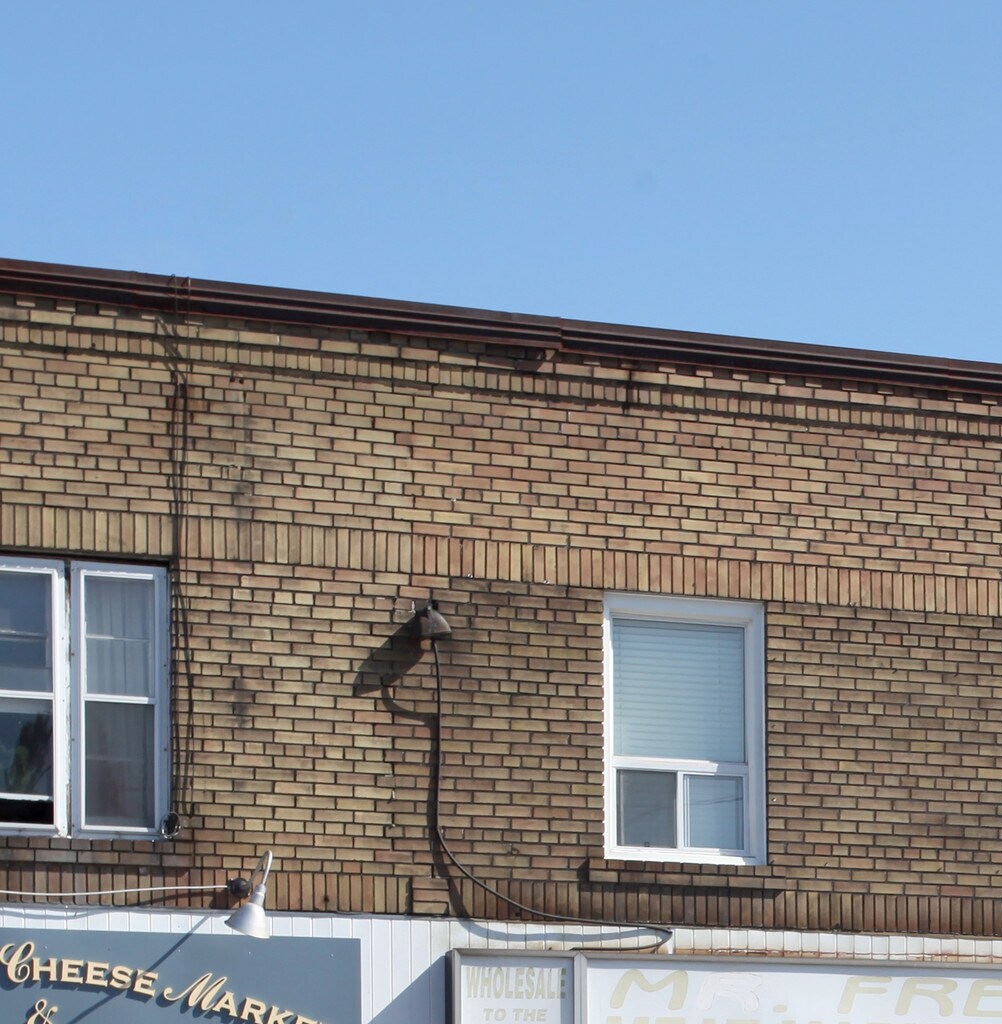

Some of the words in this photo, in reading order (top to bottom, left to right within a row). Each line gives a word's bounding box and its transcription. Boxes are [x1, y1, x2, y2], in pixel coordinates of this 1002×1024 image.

[466, 966, 567, 1000] WHOLESALE
[483, 1008, 506, 1022] TO
[512, 1008, 547, 1022] THE
